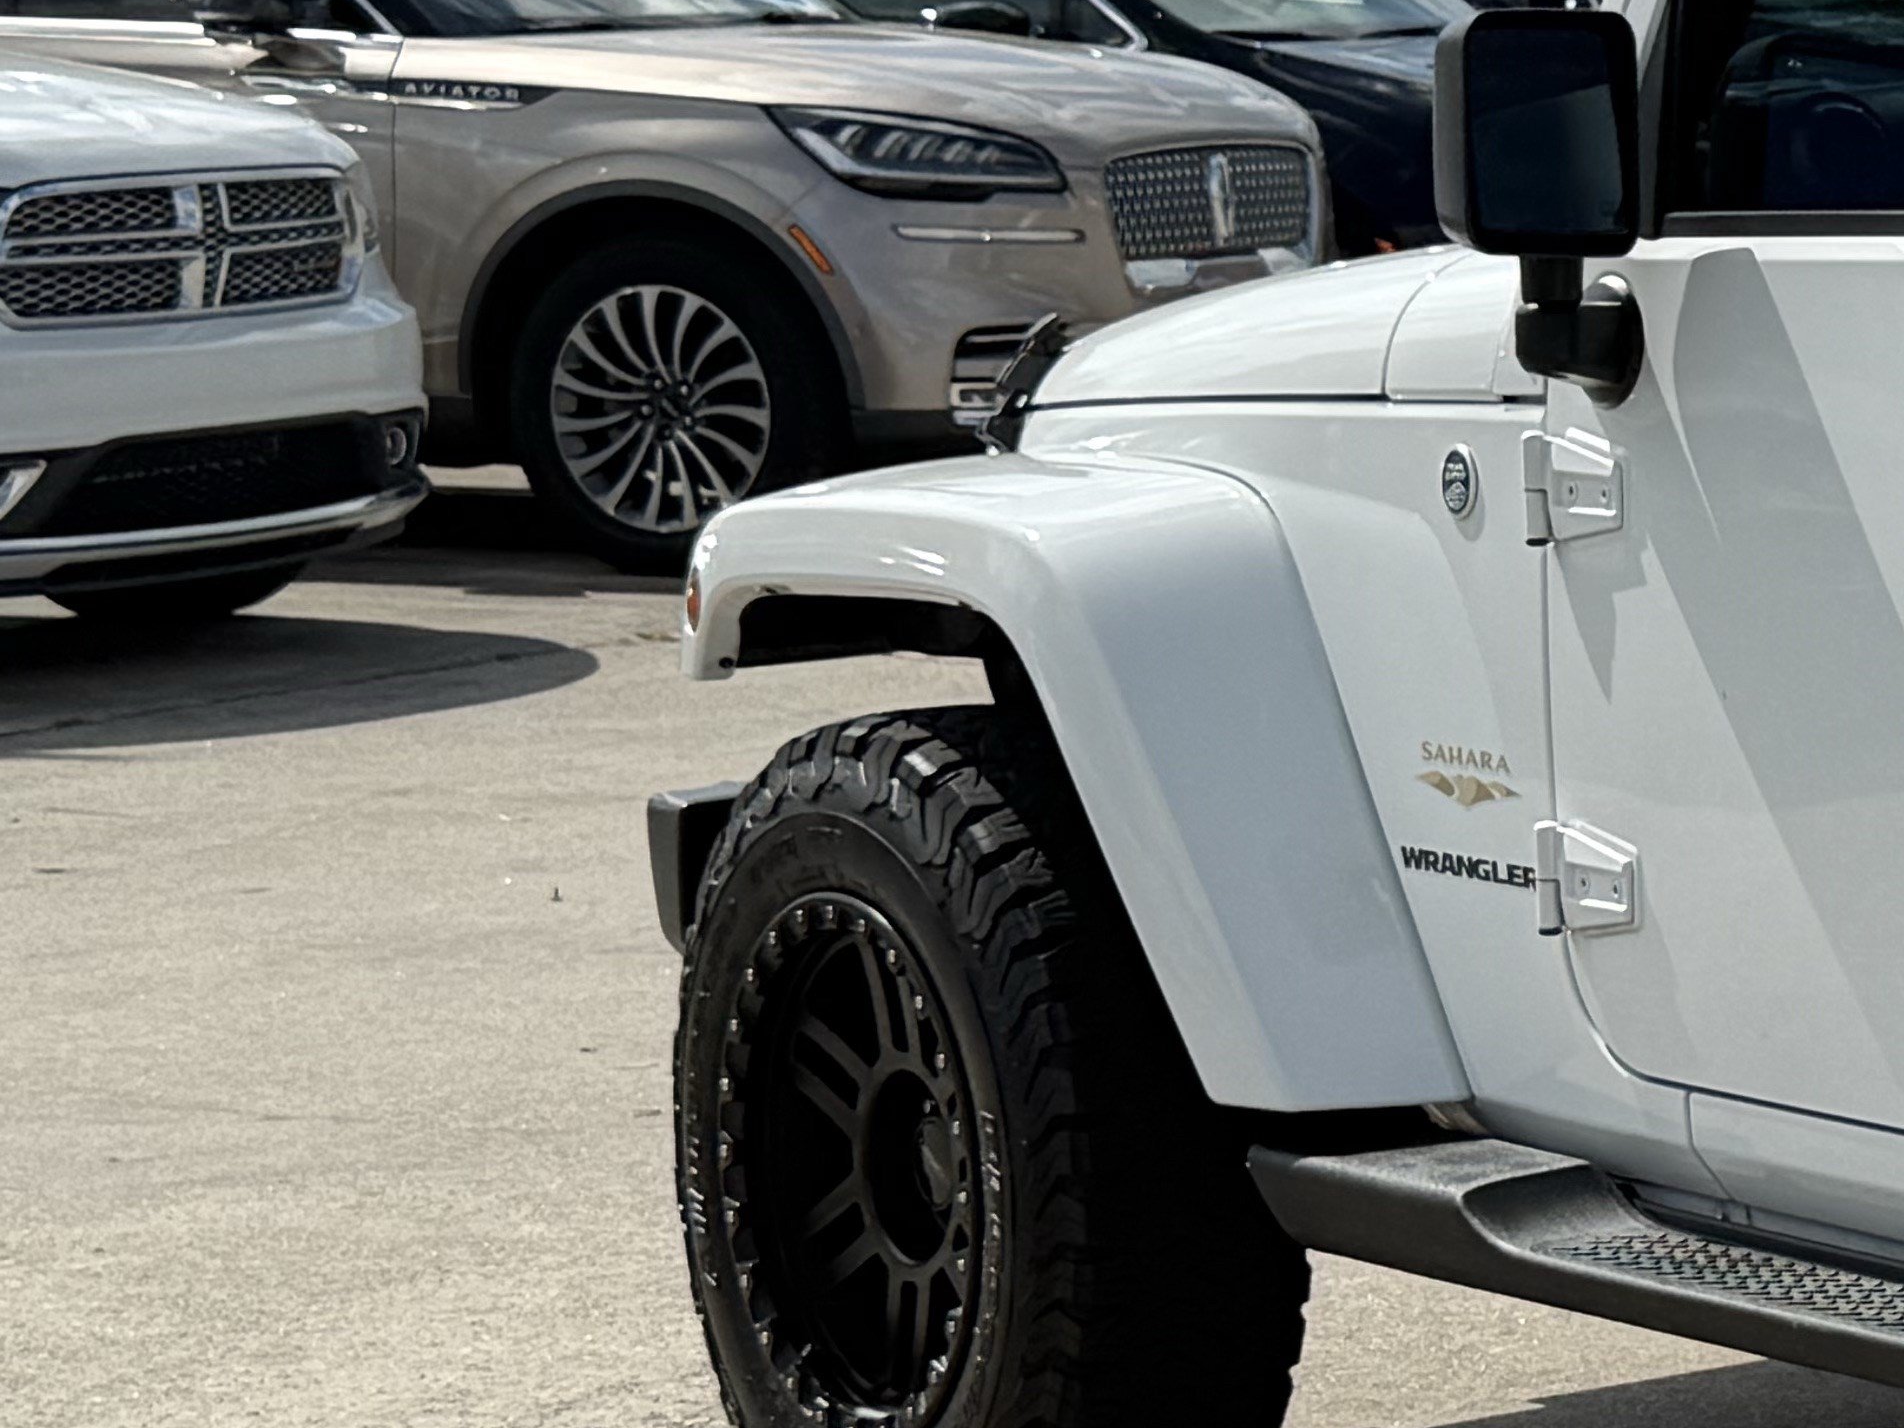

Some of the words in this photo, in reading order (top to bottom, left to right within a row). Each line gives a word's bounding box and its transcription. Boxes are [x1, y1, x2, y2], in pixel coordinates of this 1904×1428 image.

[404, 82, 519, 101] AVIATOR
[1421, 740, 1512, 774] SAHARA
[1400, 845, 1537, 892] WRANGLER
